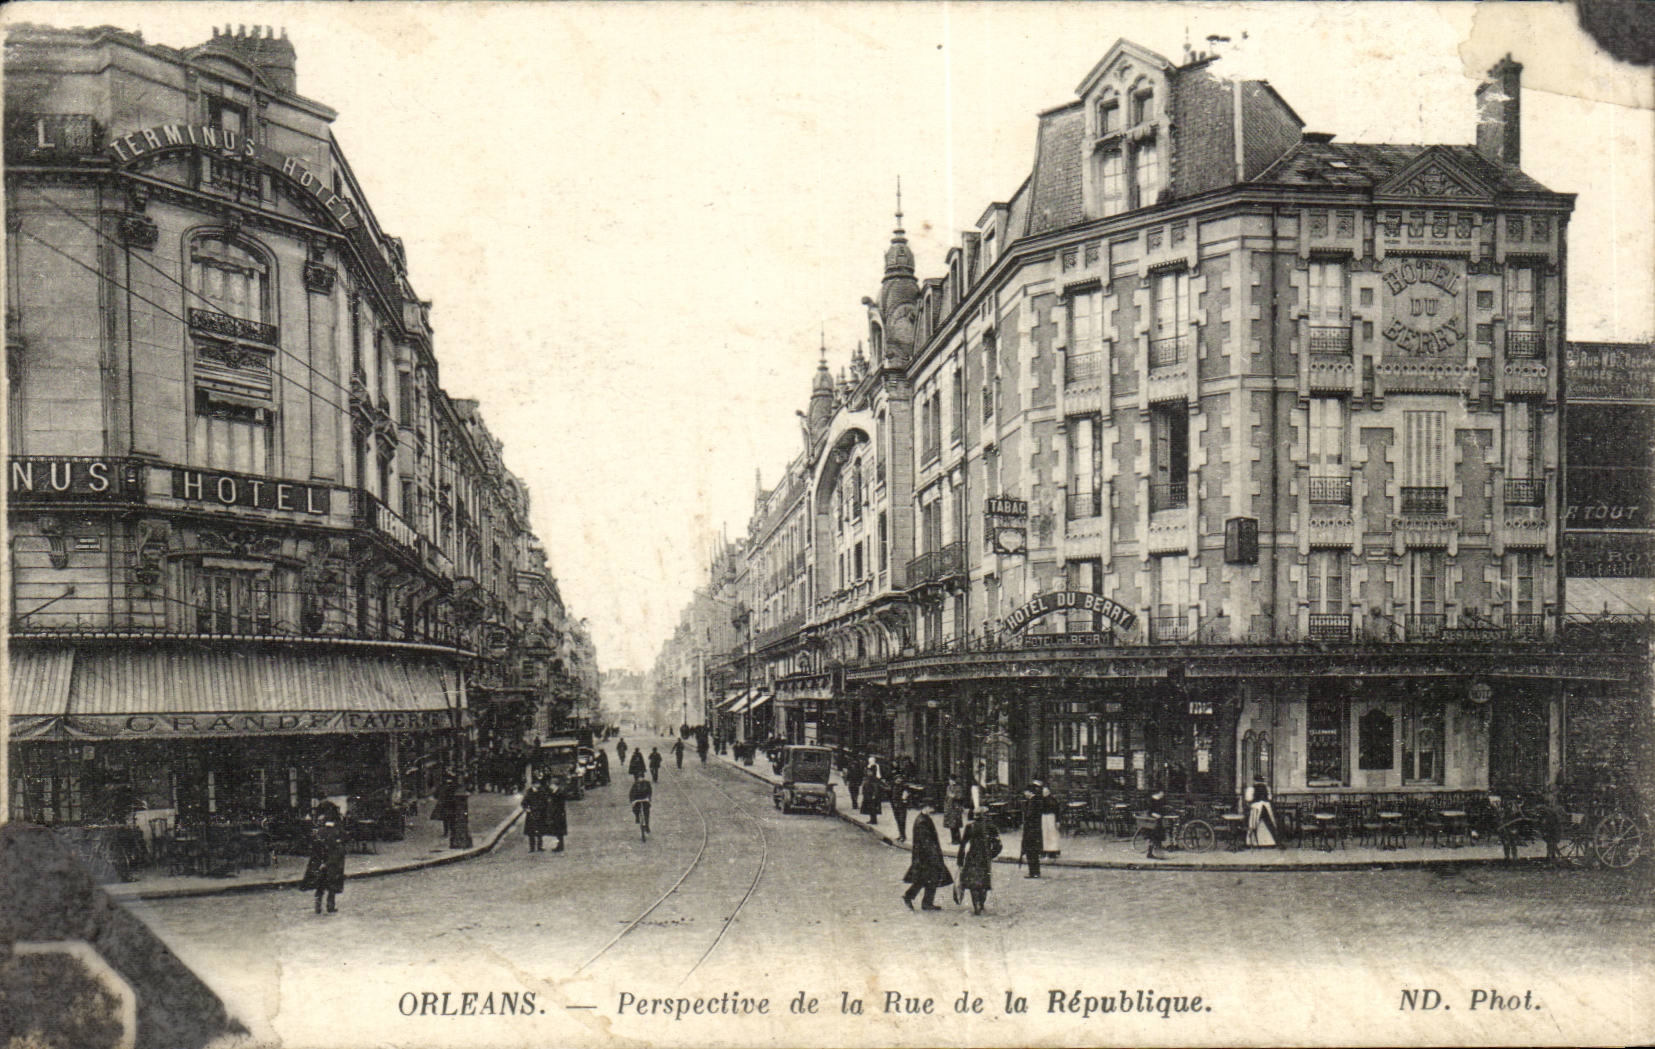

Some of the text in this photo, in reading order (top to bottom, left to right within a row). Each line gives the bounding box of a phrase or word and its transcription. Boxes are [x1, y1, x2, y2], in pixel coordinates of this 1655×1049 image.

[109, 124, 350, 227] TERMINUS HOTEL
[1409, 297, 1439, 317] DU
[1382, 316, 1466, 354] BERRY
[12, 461, 110, 492] NUS
[183, 473, 324, 514] HOTEL
[990, 500, 1026, 514] TABAC
[1006, 592, 1132, 630] HOTEL DU BERRY
[125, 714, 331, 732] GRANDE
